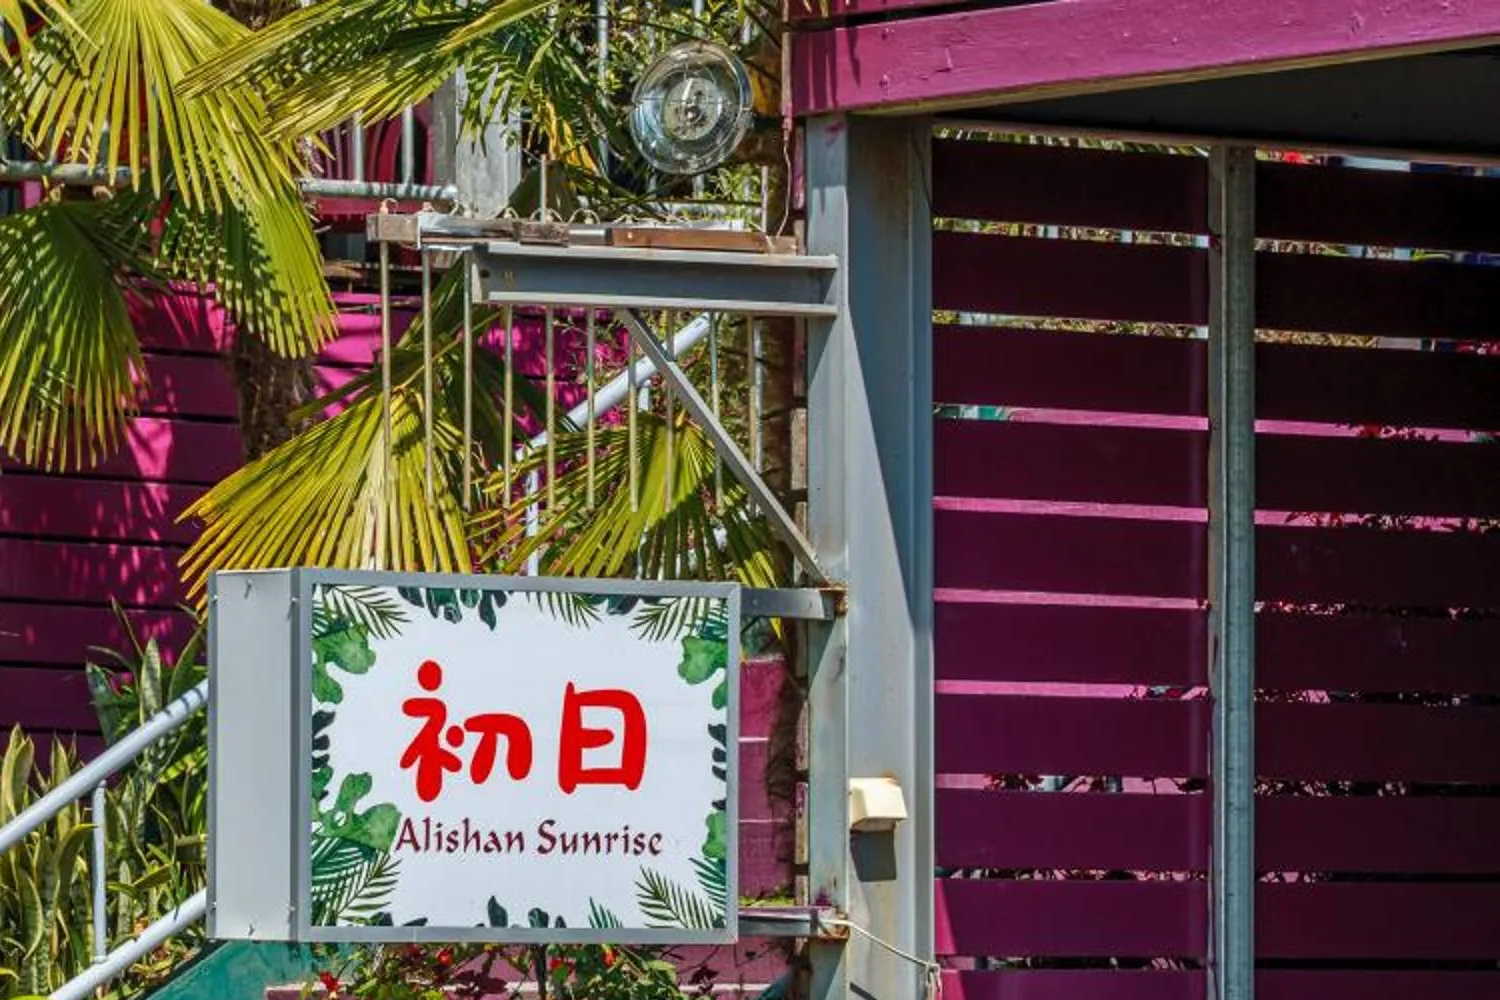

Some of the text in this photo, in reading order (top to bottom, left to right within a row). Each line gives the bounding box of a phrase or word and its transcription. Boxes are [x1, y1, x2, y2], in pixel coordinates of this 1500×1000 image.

[399, 659, 648, 802] 初日
[395, 817, 663, 857] Alishan Sunrise
